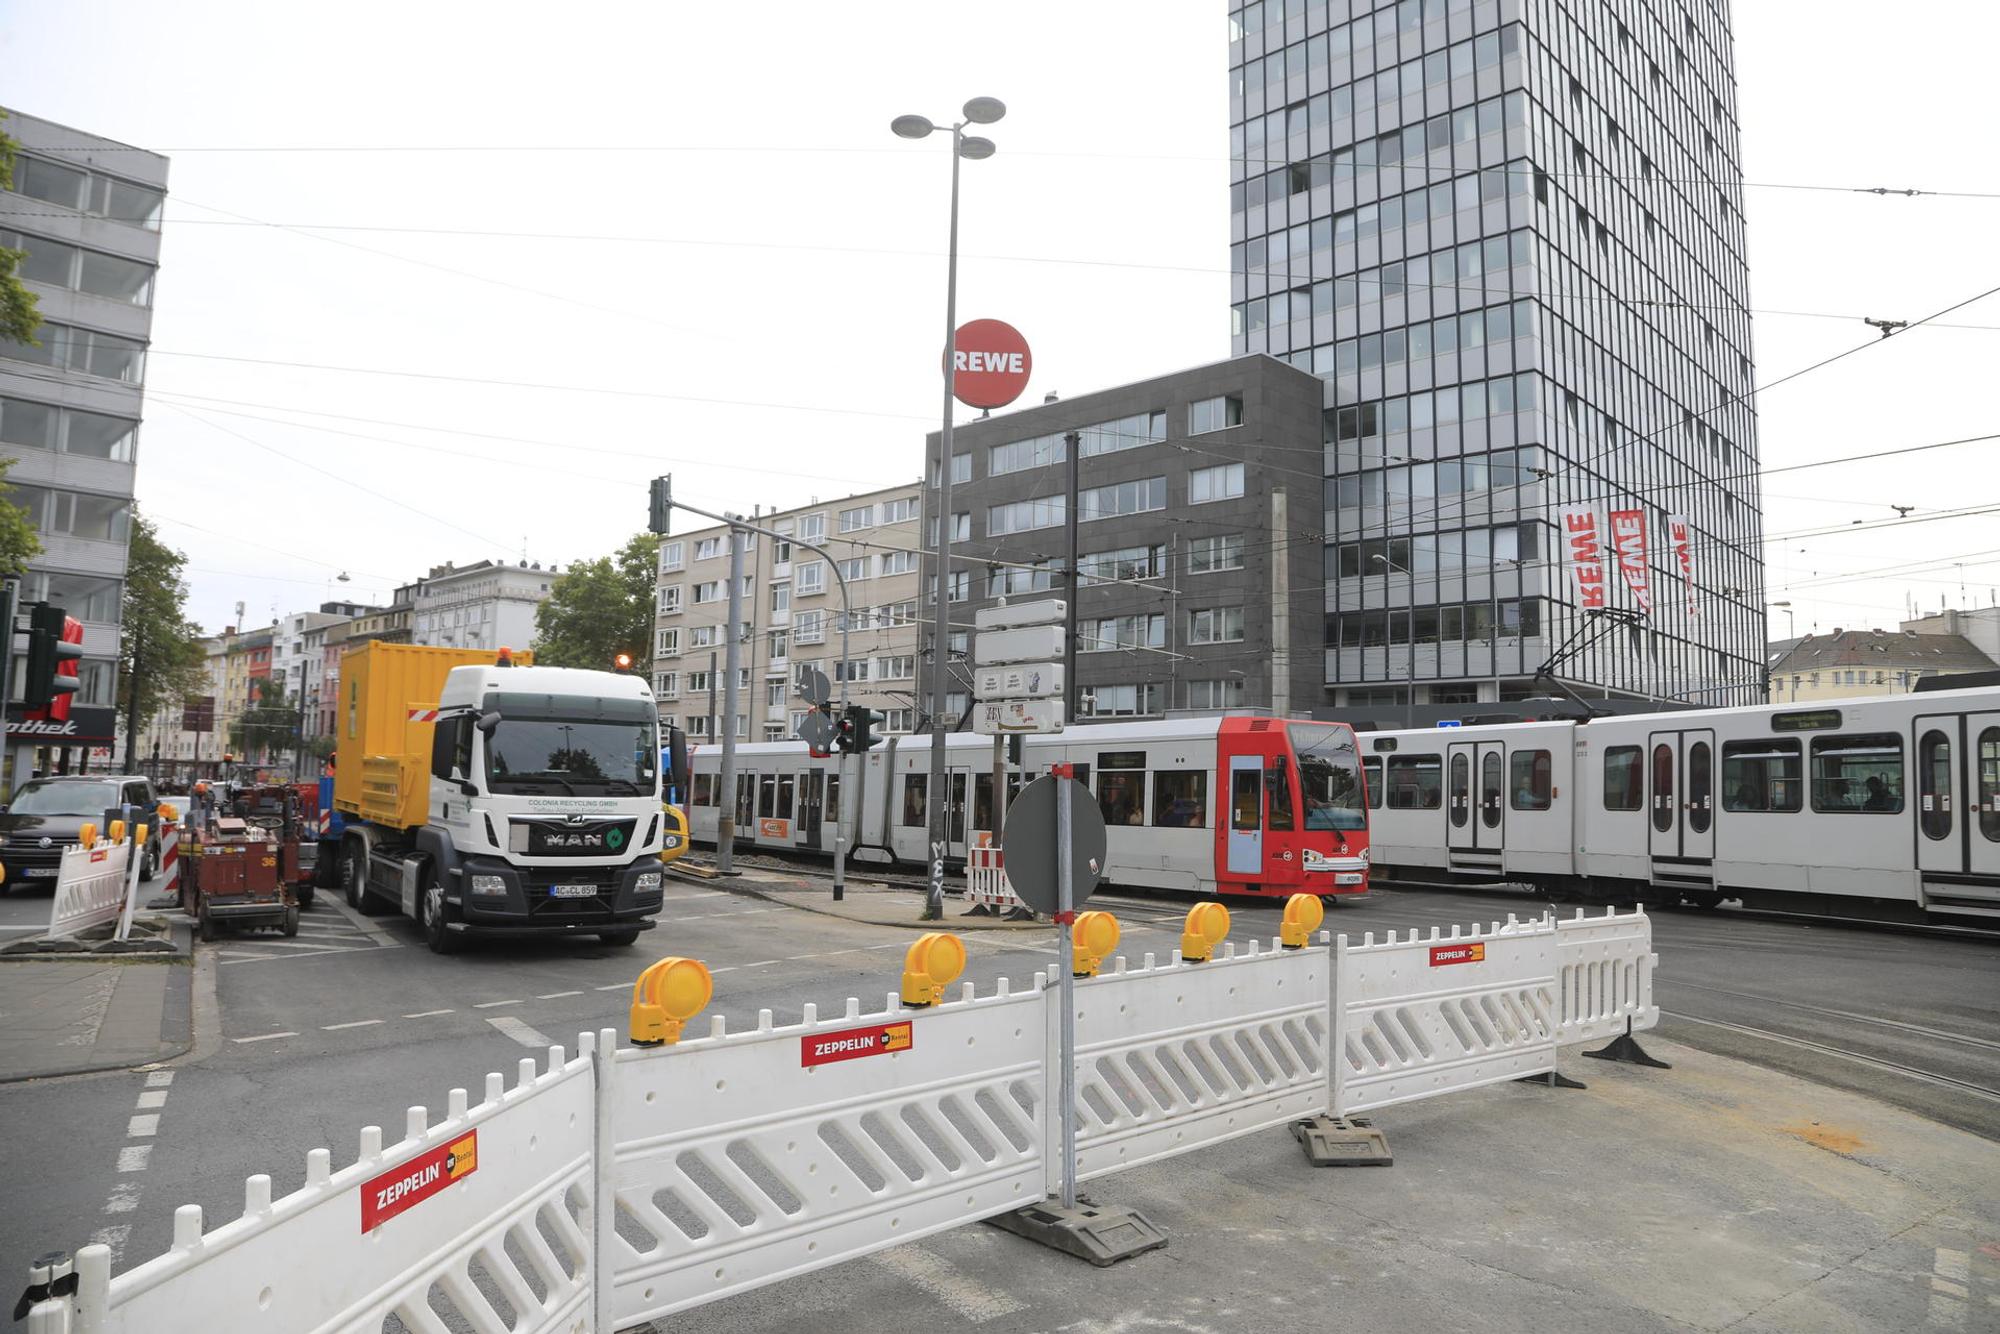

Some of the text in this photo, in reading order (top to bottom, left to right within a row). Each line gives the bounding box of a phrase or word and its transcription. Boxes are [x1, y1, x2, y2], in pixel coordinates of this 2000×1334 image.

[954, 351, 1024, 373] REWE
[1566, 511, 1604, 608] REWE
[546, 834, 602, 847] MAN
[582, 886, 596, 894] 859
[1436, 950, 1466, 960] ZEPPELIN
[815, 1036, 874, 1056] ZEPPELIN
[376, 1161, 440, 1210] ZEPPELIN
